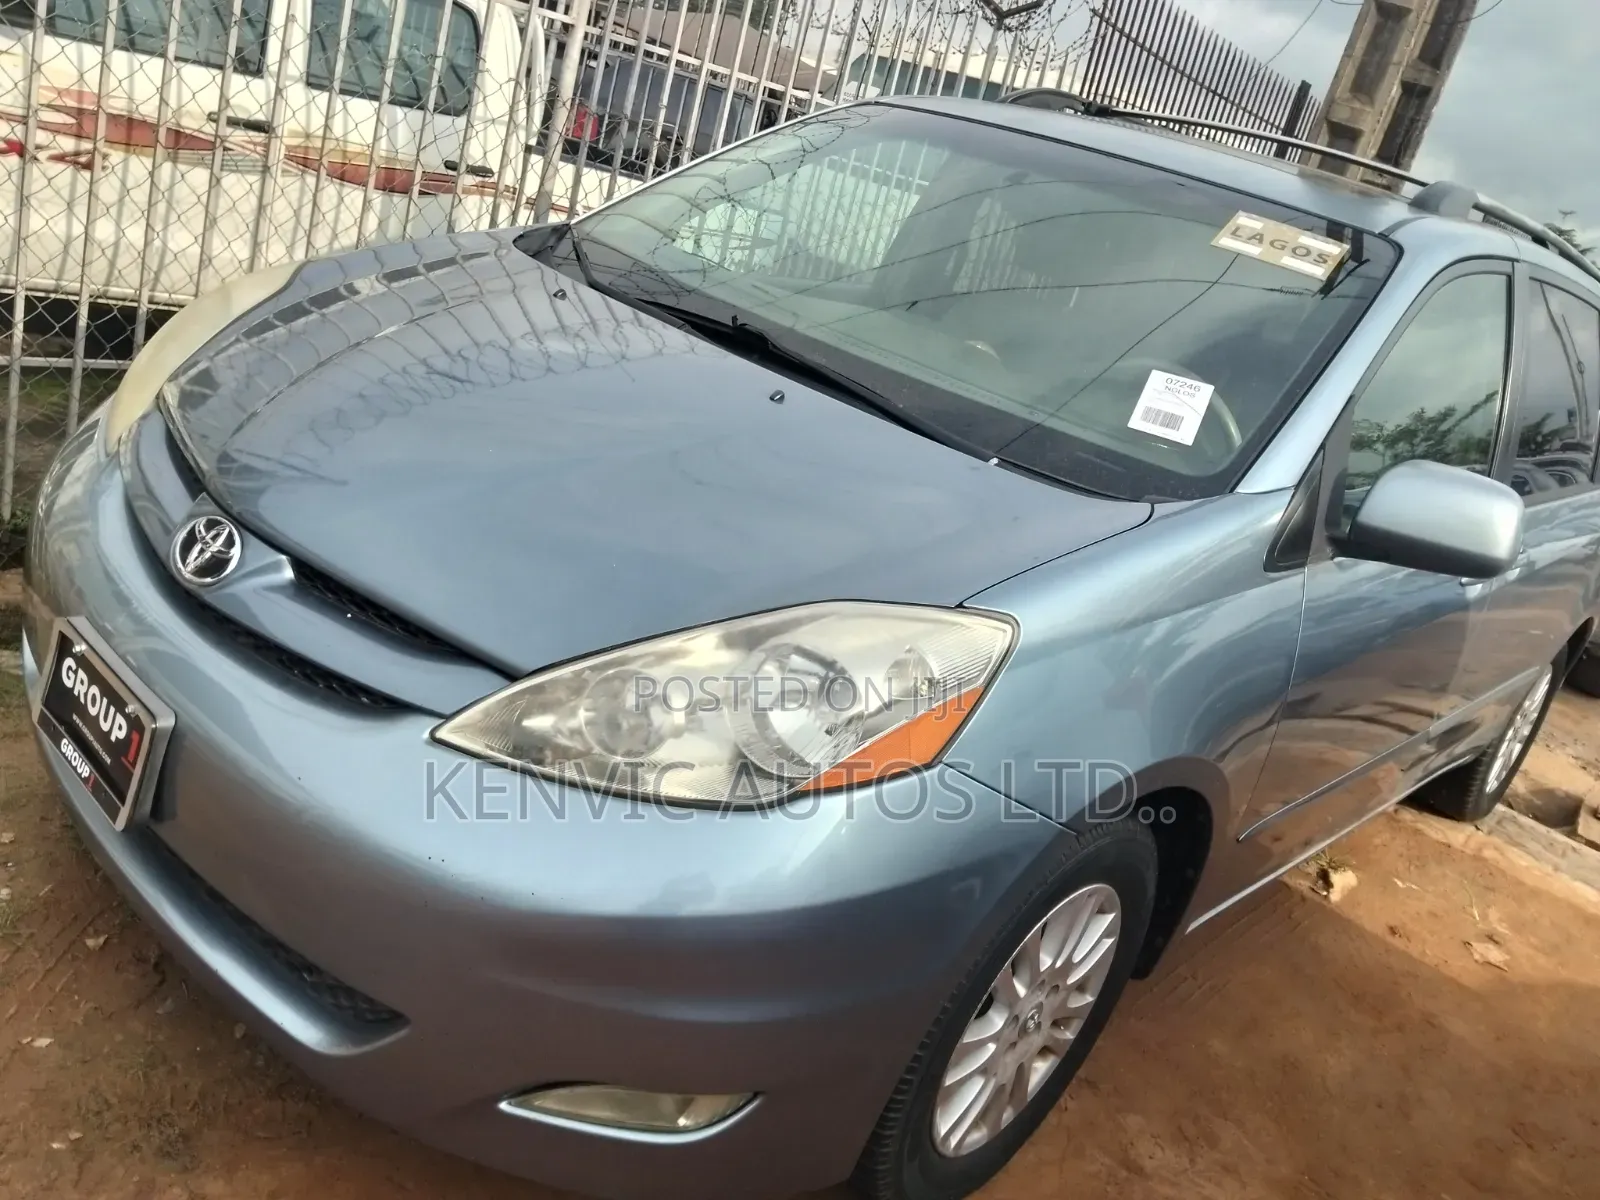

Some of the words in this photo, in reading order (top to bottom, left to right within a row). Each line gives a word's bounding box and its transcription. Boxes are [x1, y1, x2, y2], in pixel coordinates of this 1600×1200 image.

[1230, 226, 1331, 265] LAGOS
[1165, 377, 1201, 393] 07246
[61, 656, 128, 743] GROUP
[121, 729, 140, 773] 1
[60, 737, 90, 779] GROUP
